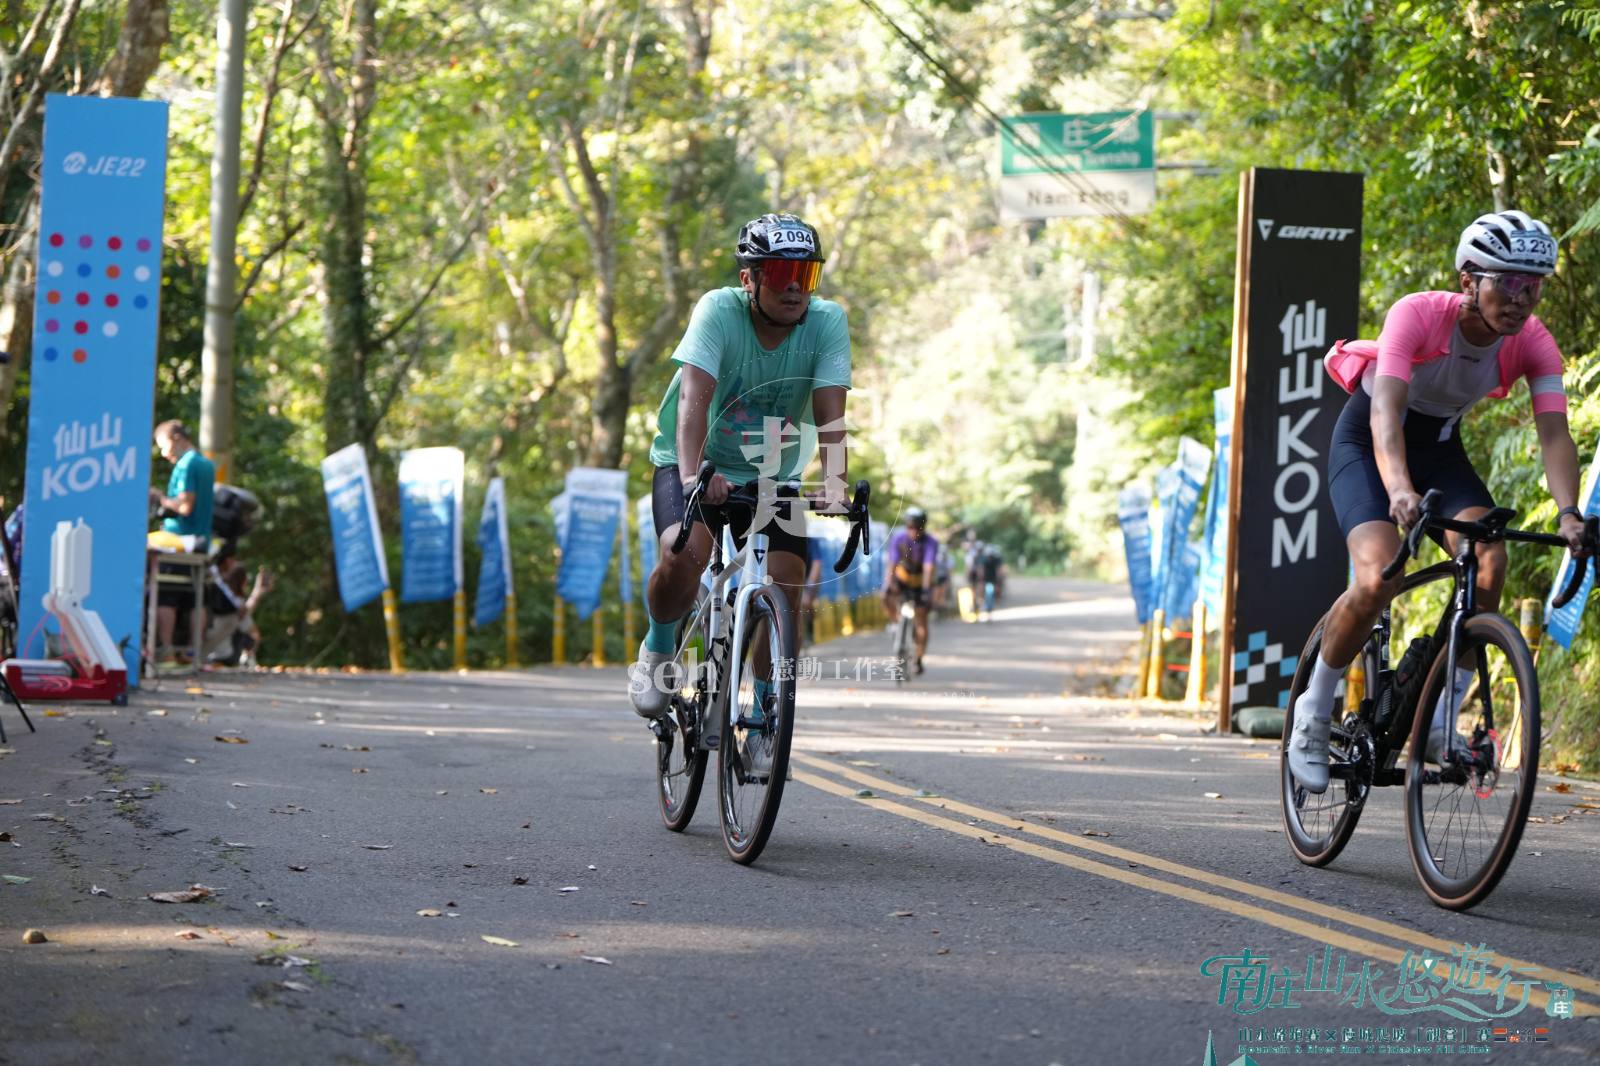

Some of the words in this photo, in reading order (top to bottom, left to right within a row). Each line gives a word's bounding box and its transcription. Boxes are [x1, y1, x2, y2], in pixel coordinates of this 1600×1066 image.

[88, 156, 146, 177] JE22
[1278, 225, 1355, 241] GIANT
[1278, 300, 1327, 404] 仙山
[53, 412, 123, 461] 仙山
[42, 446, 137, 500] KOM
[1272, 407, 1321, 569] KOM
